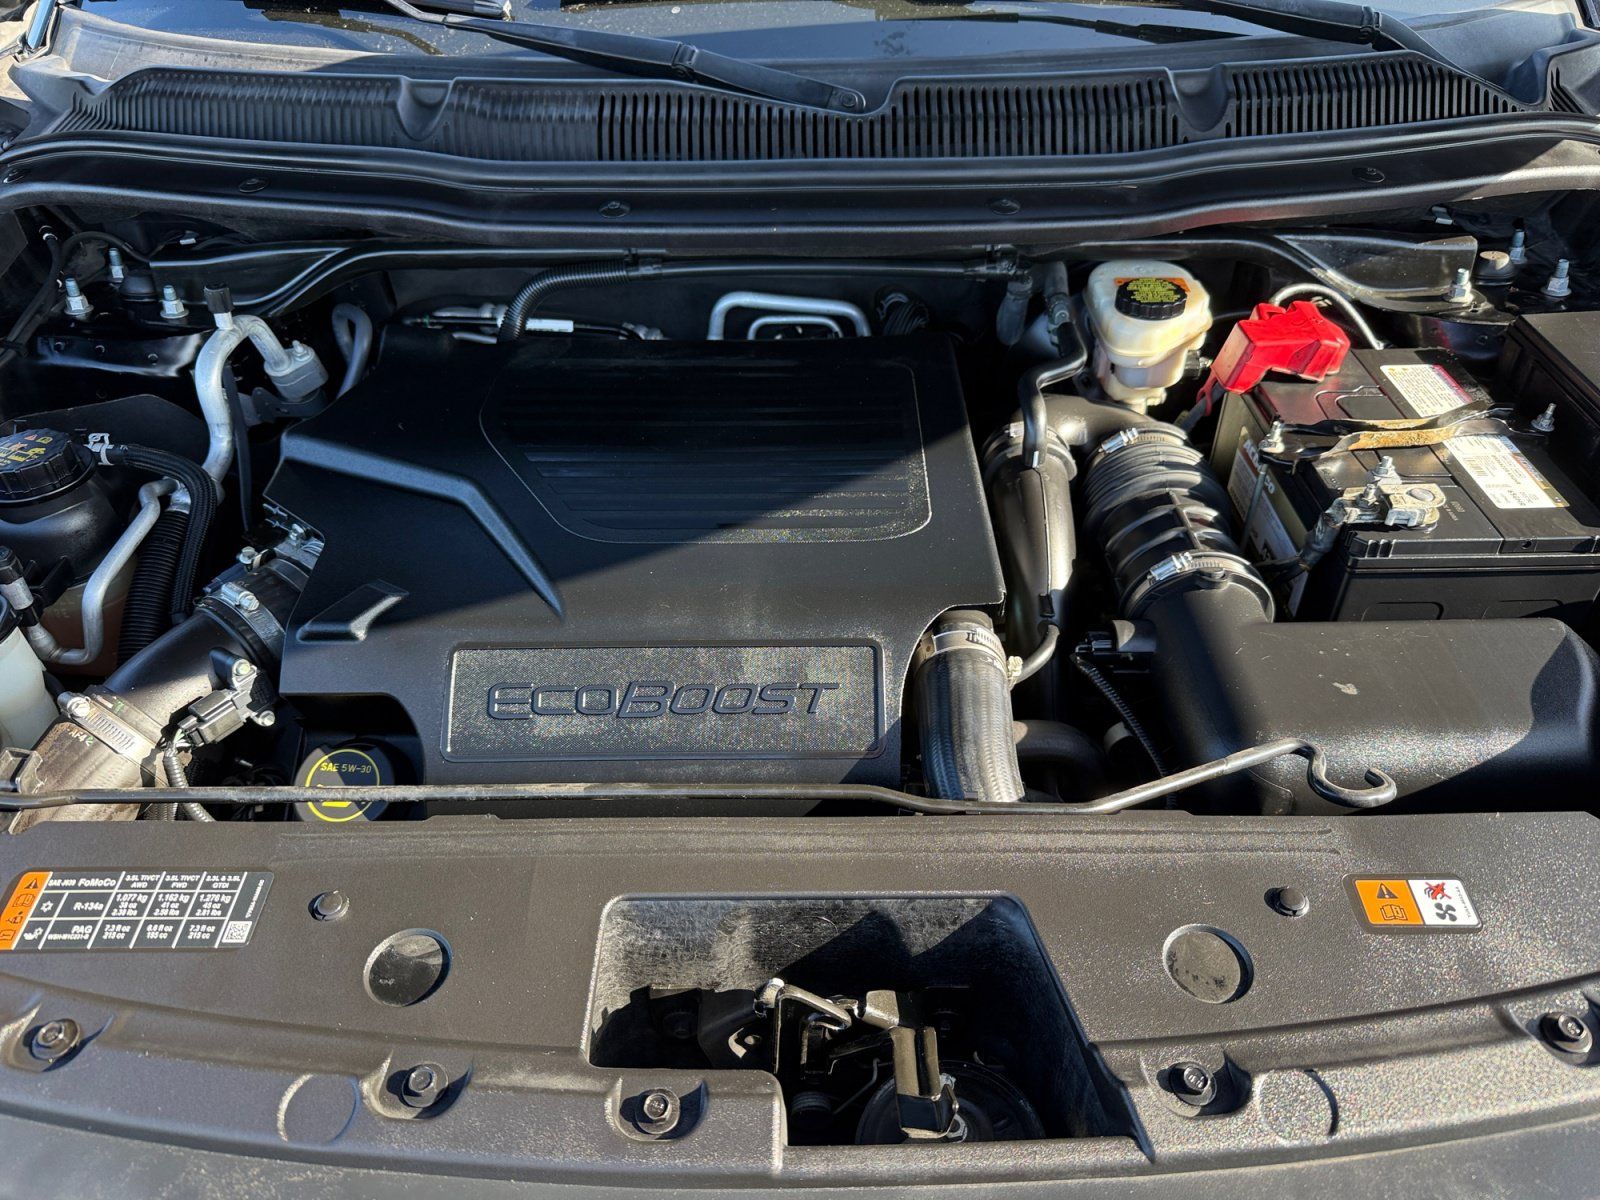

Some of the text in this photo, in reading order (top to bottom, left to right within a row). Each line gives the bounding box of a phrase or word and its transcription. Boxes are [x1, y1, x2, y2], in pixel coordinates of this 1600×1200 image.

[319, 762, 372, 773] SAE 5W-30
[78, 877, 117, 887] FoMoCo
[116, 893, 149, 904] 1.077 kg
[157, 894, 190, 904] 1.162 kg
[221, 894, 232, 904] kg
[73, 902, 104, 911] R-134a
[71, 925, 93, 934] PAG
[103, 932, 116, 940] 215
[188, 932, 201, 940] 215
